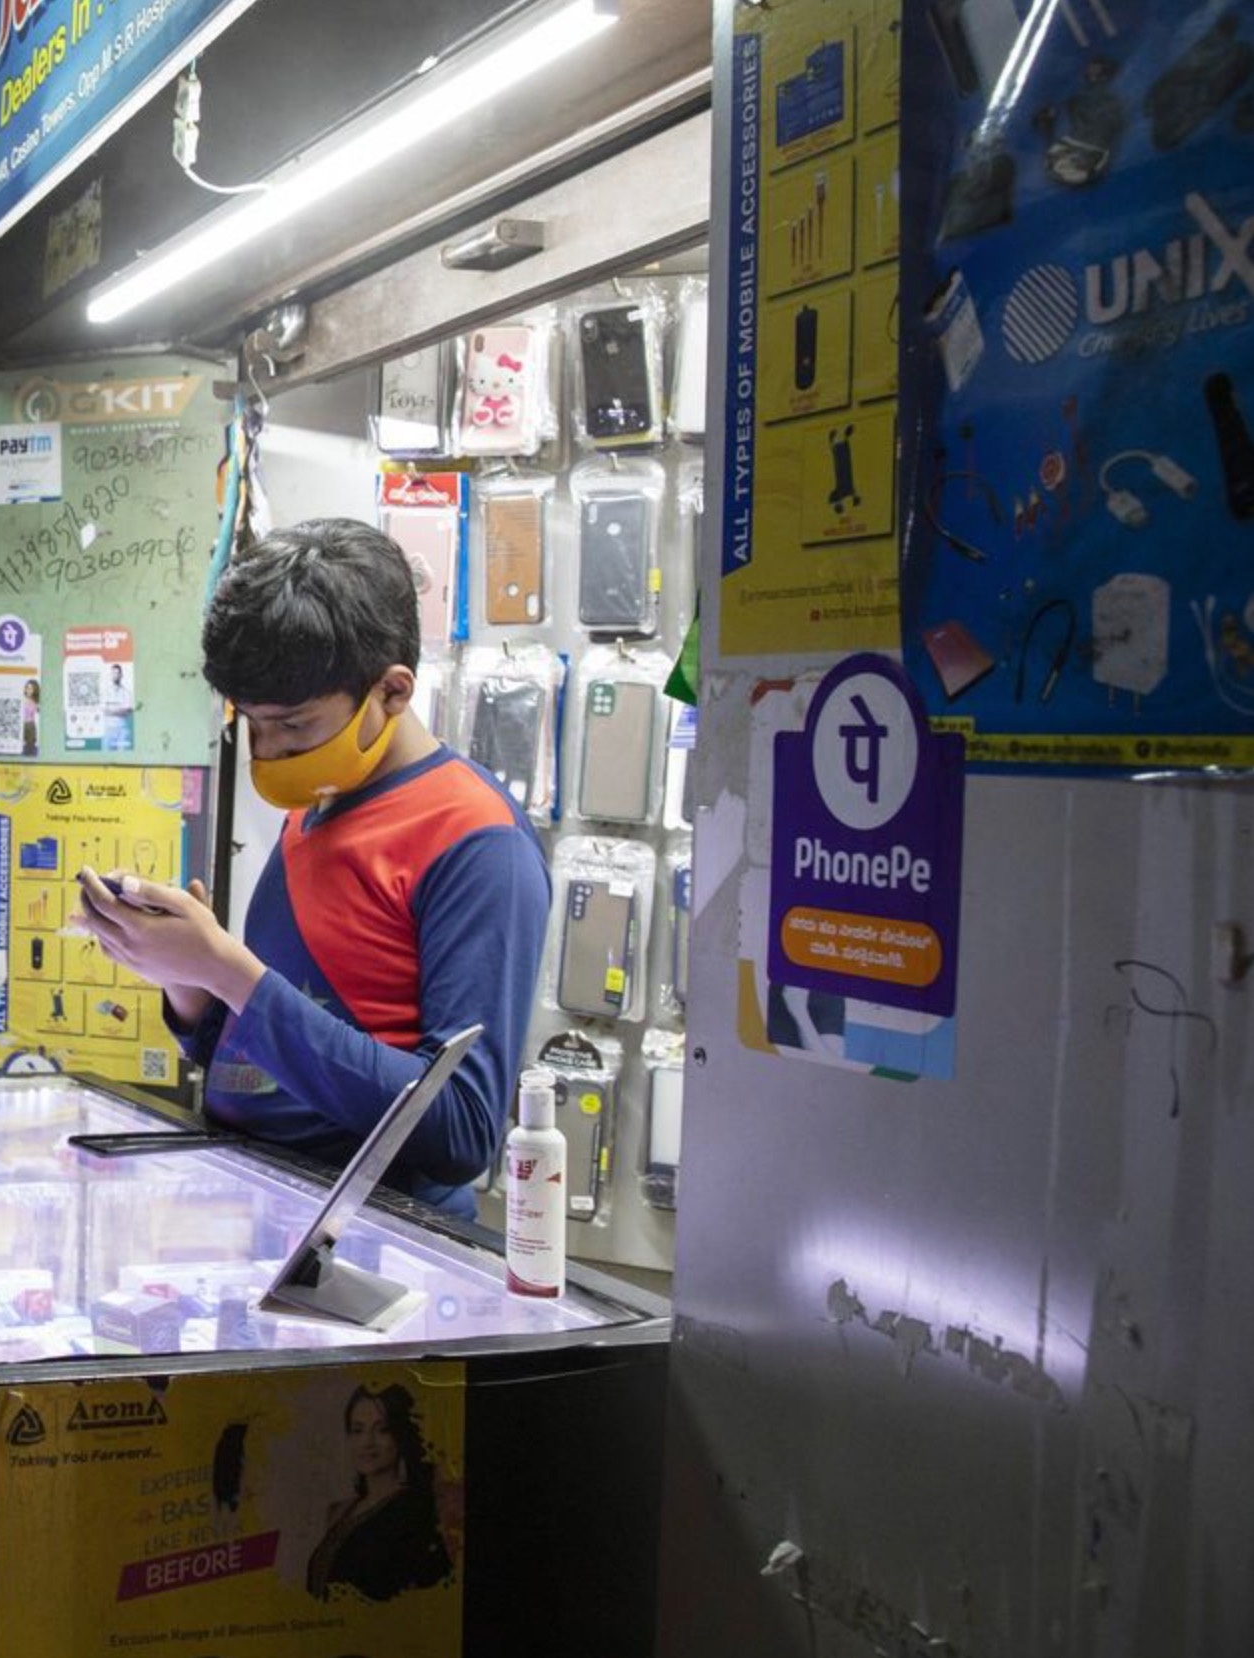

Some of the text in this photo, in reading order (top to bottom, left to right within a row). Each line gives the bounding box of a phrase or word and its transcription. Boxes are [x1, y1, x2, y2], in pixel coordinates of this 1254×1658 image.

[0, 25, 66, 127] Dealers
[734, 37, 760, 563] ALL TYPES OF MOBILE ACCESSORIES
[0, 819, 9, 900] ACCESSORIES
[794, 837, 932, 894] PhonePe
[10, 1455, 58, 1467] Taking
[61, 1451, 88, 1464] You
[161, 1493, 214, 1525] BAS
[146, 1545, 243, 1589] BEFORE
[170, 1628, 210, 1643] Range
